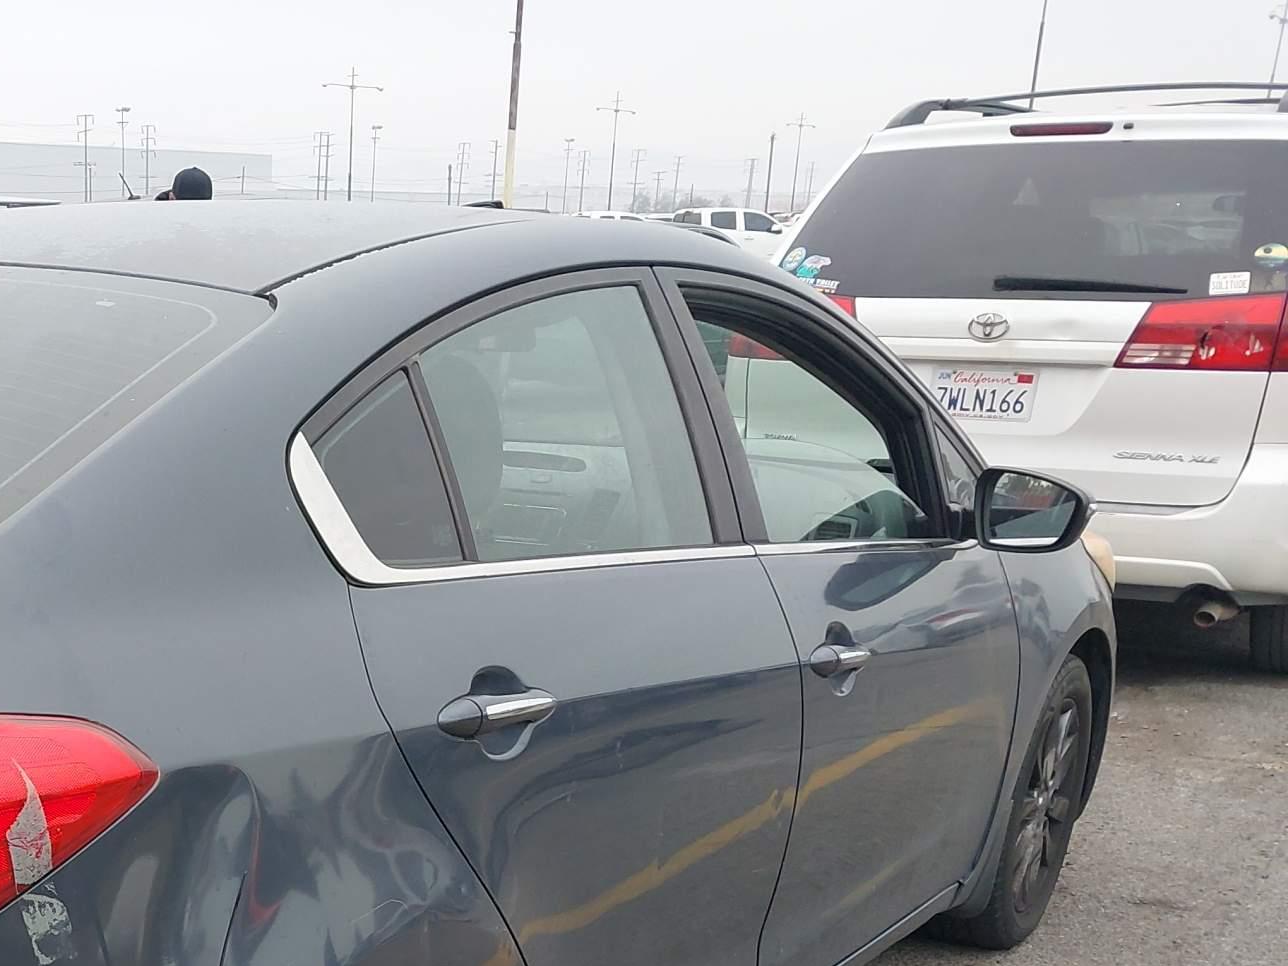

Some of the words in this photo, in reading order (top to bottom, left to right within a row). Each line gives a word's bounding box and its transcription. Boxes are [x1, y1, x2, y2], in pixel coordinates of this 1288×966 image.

[953, 370, 1016, 387] California
[937, 387, 1028, 414] 7WLN166
[1112, 451, 1184, 463] SIENNA
[1187, 455, 1221, 464] XLE
